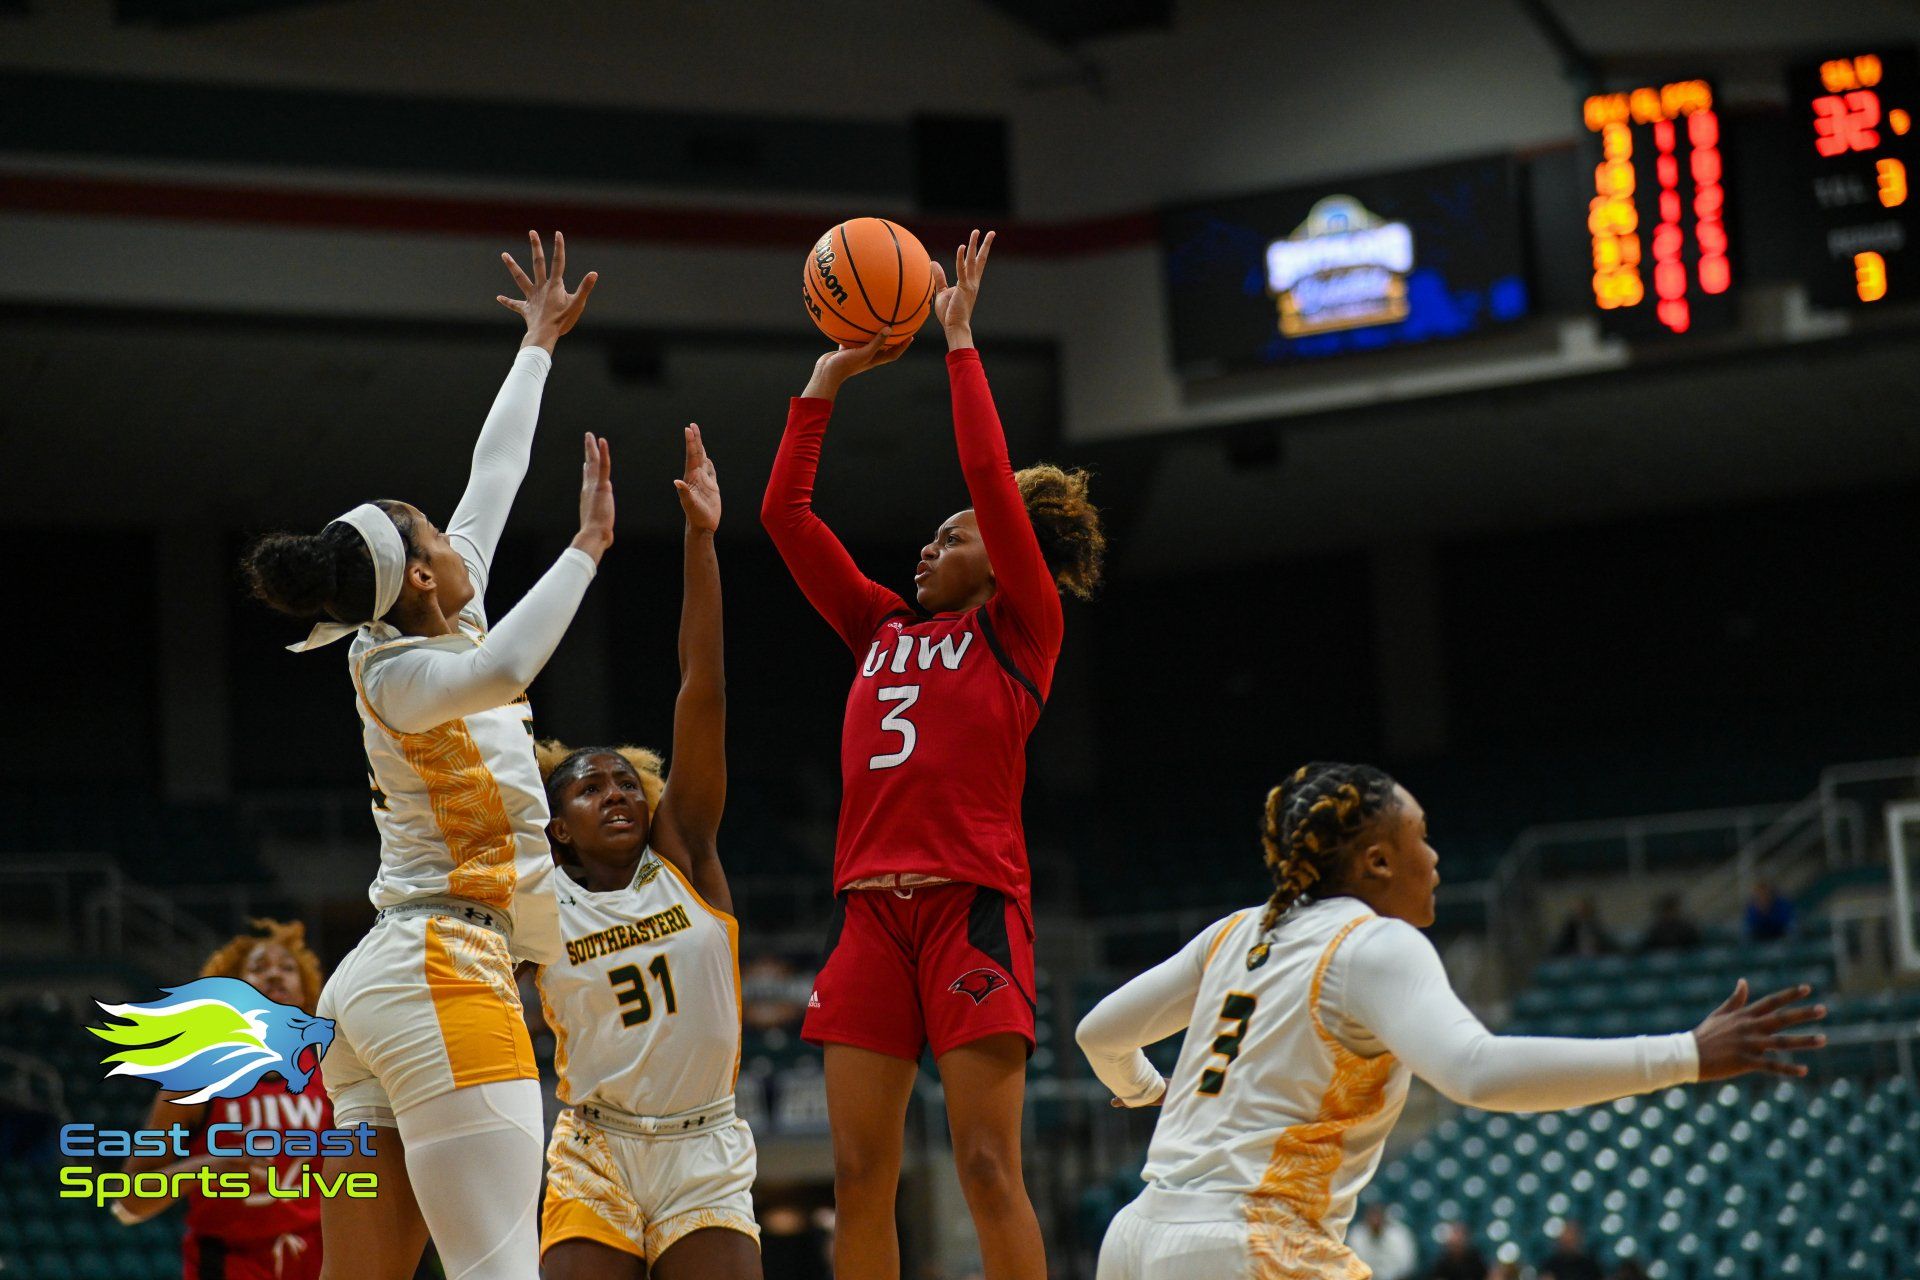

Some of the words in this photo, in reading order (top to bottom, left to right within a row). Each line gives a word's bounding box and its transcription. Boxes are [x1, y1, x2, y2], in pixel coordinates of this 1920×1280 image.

[862, 631, 974, 678] UIW
[869, 684, 921, 770] 3
[565, 902, 693, 968] SOUTHEASTERN
[607, 951, 678, 1030] 31
[1196, 990, 1259, 1098] 3
[225, 1094, 323, 1134] UIW
